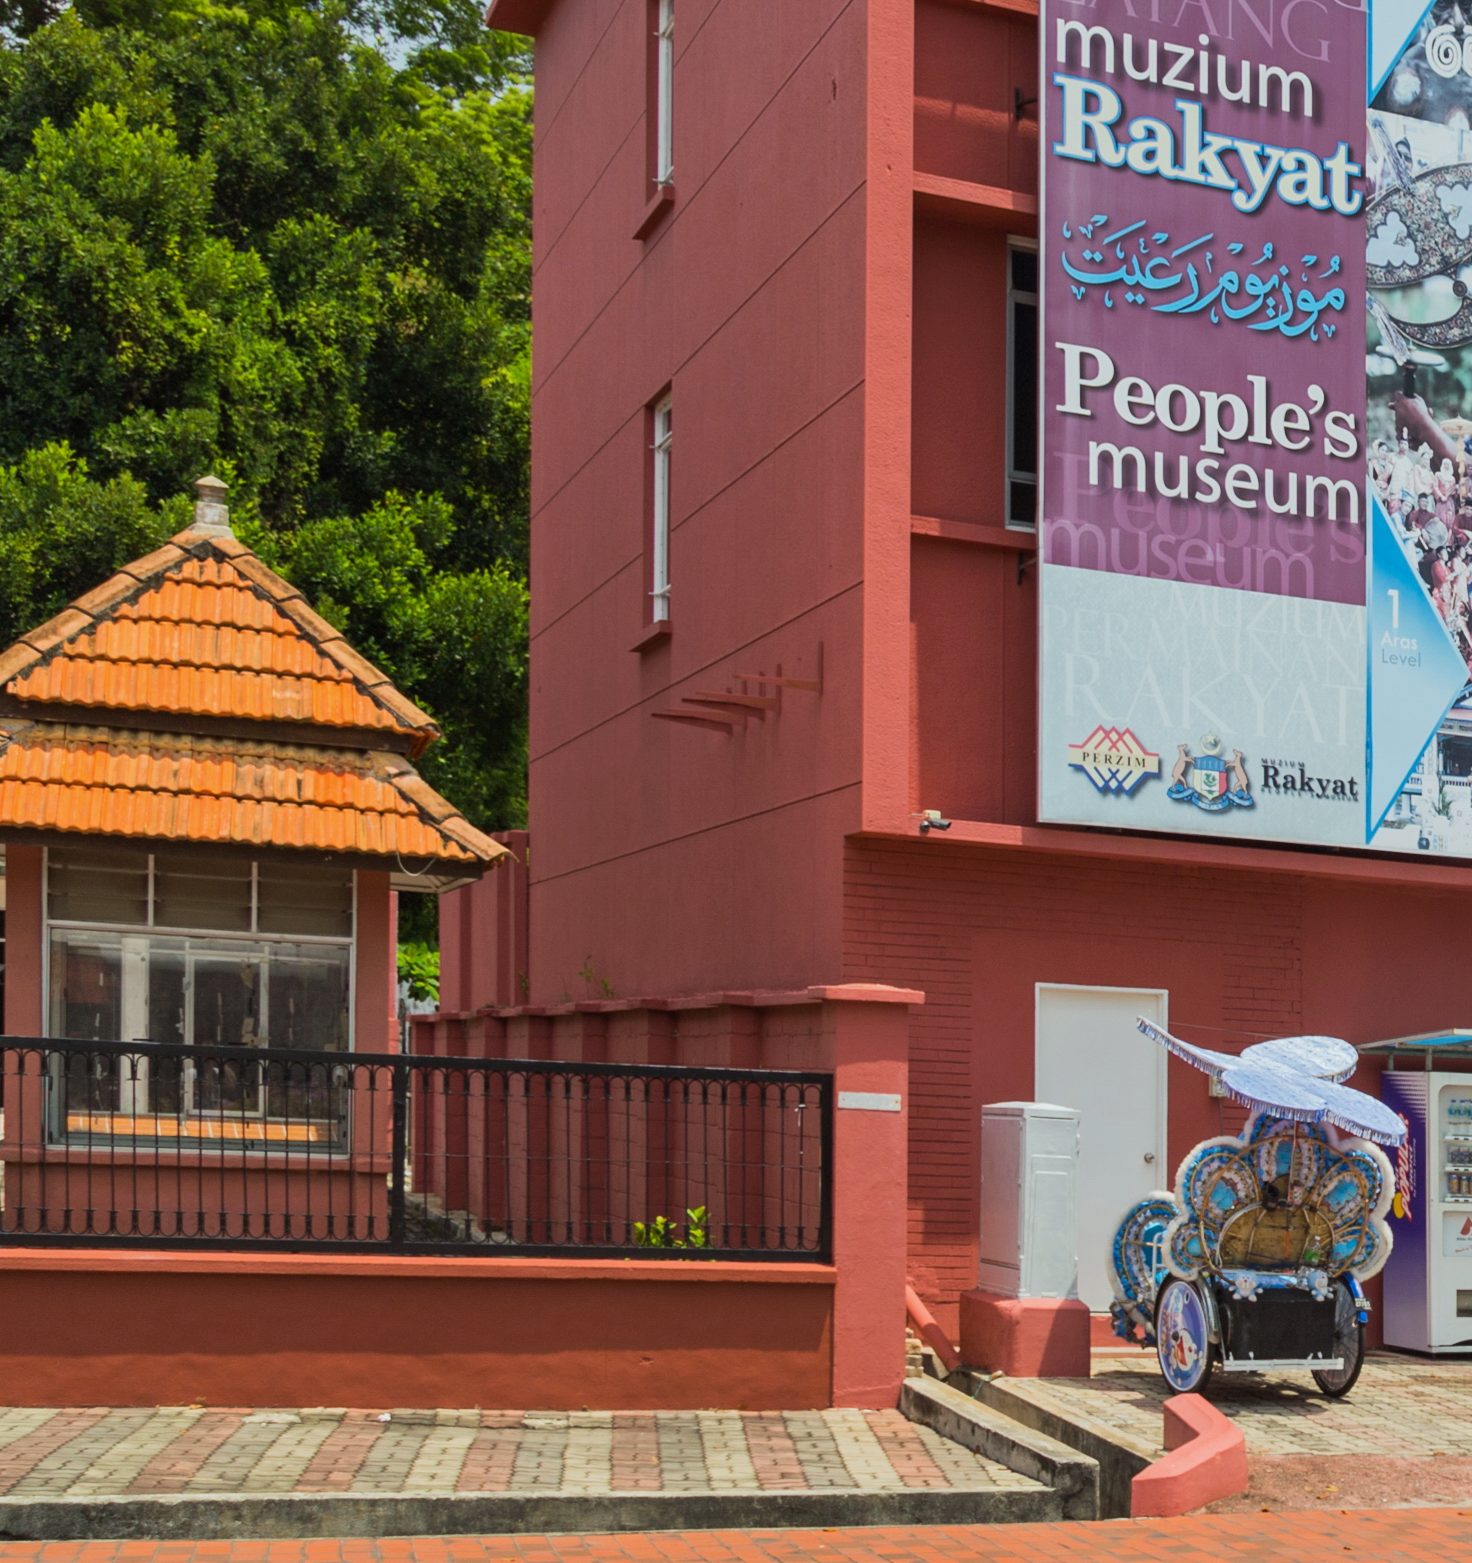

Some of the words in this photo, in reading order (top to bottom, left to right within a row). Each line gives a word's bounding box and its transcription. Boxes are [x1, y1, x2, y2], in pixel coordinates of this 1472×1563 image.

[1056, 17, 1313, 118] muzium
[1053, 71, 1363, 215] Rakyat
[1088, 440, 1359, 524] museum
[1043, 519, 1315, 600] museum
[1387, 588, 1400, 629] 1
[1381, 631, 1418, 650] Aras
[1382, 648, 1421, 668] Level
[1064, 651, 1364, 747] RAKYAT
[1082, 751, 1147, 769] PERZIM
[1261, 757, 1305, 768] MUZIUM
[1261, 764, 1359, 799] Rakyat
